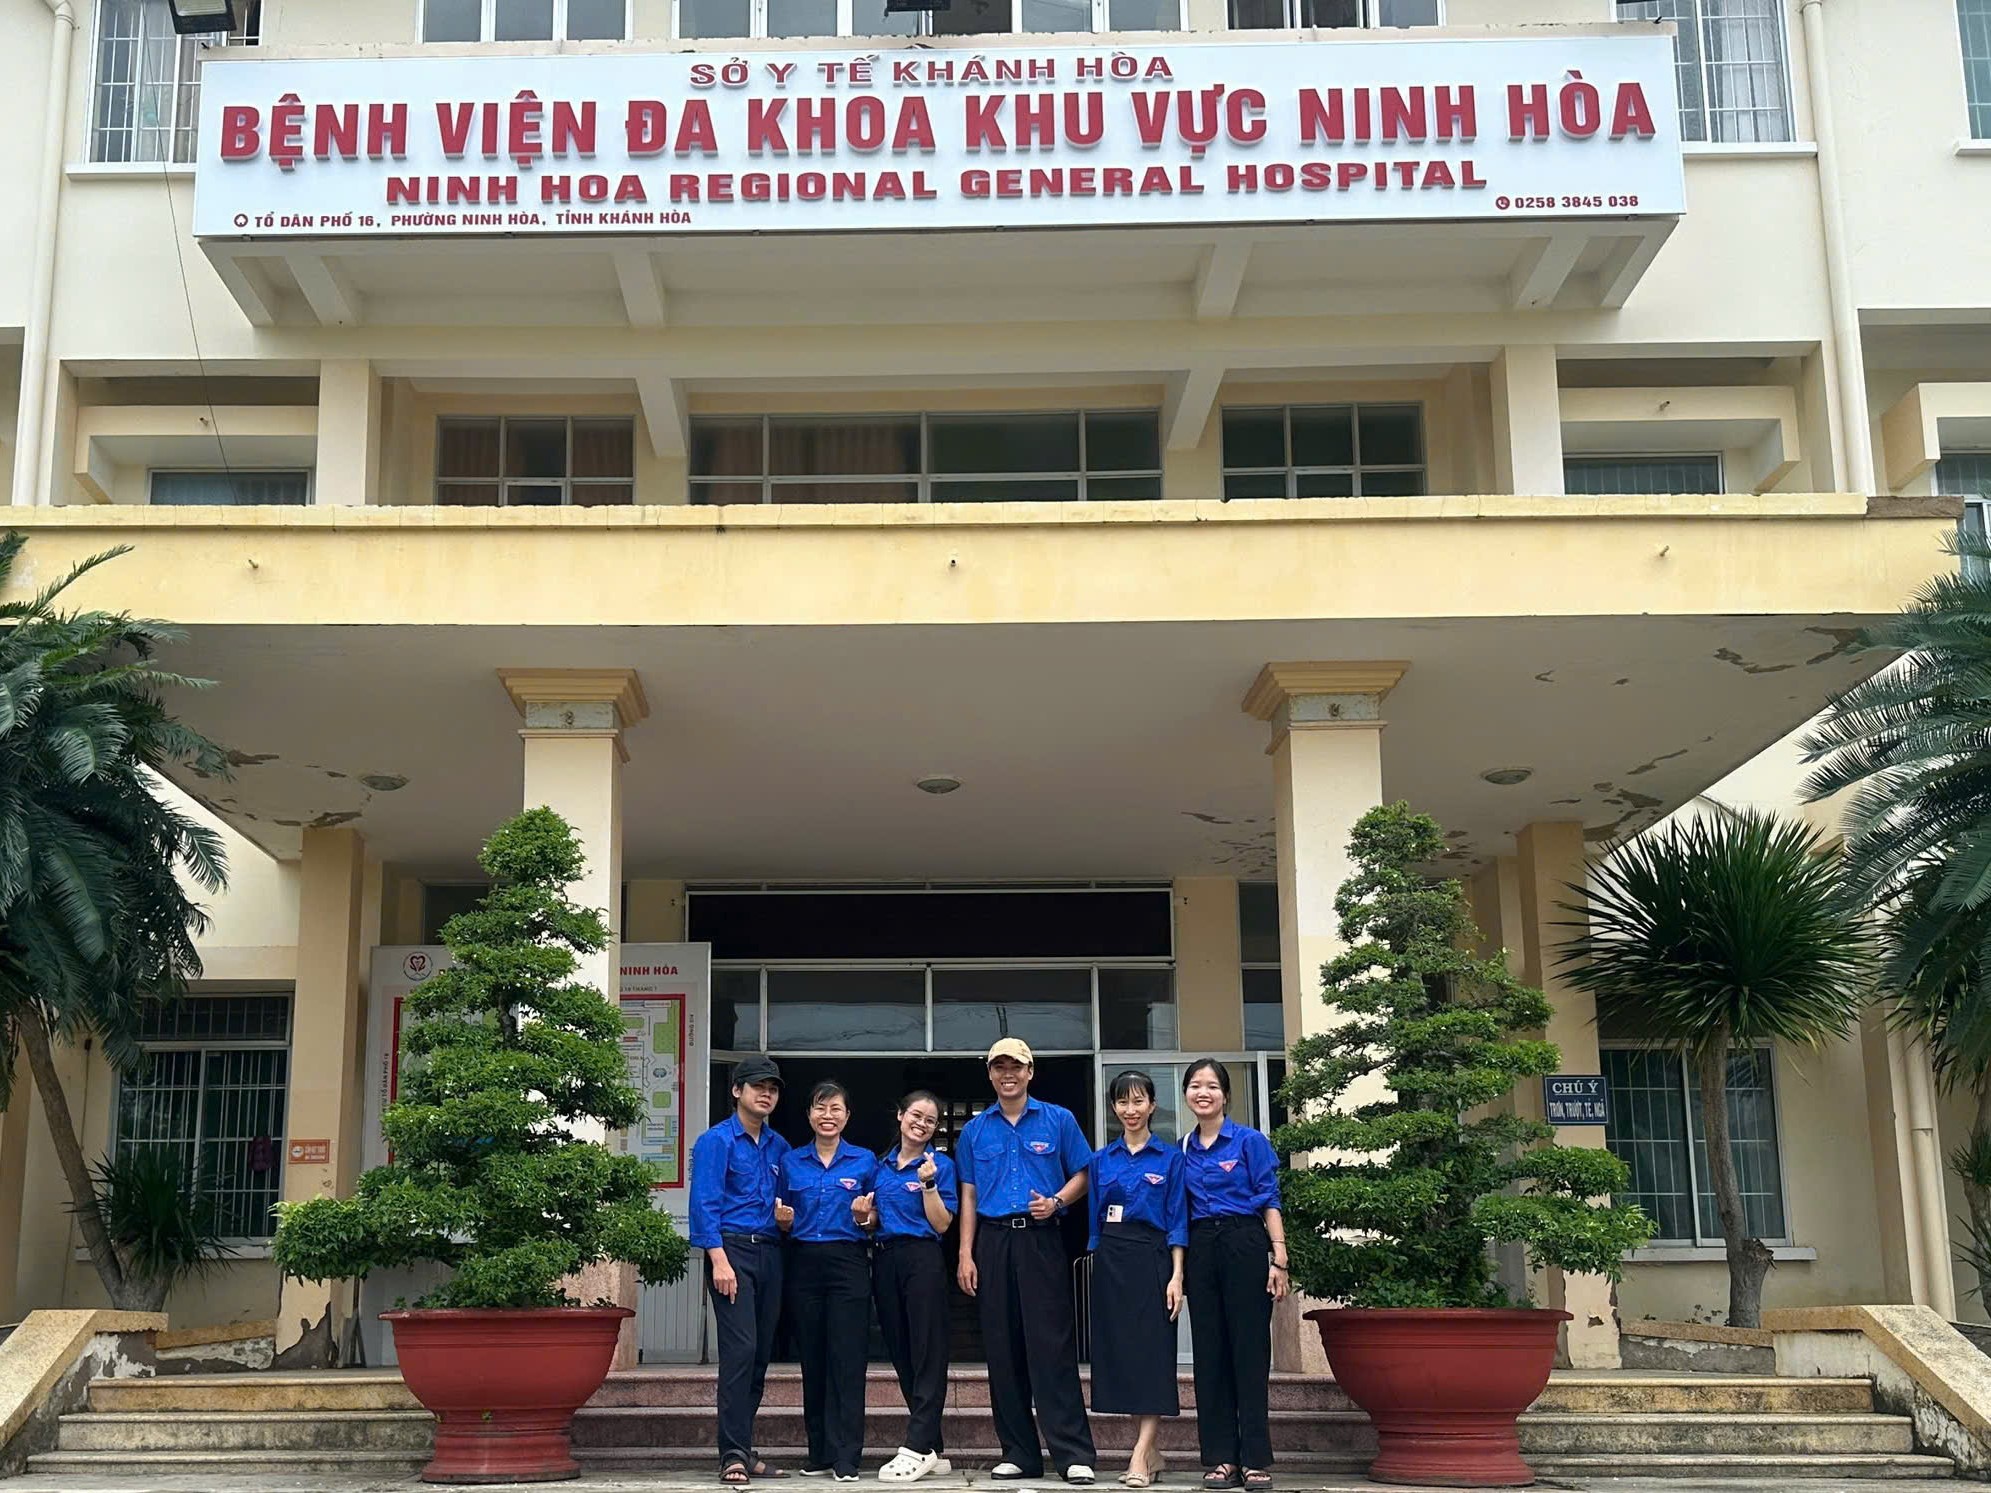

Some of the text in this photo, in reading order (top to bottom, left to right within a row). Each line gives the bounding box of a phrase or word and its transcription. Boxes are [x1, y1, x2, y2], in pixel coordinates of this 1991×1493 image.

[690, 52, 1173, 87] SỞ Y TẾ KHÁNH HÒA
[220, 70, 1656, 168] BỆNH VIỆN ĐA KHOA KHU VỰC NINH HÒA
[386, 160, 1486, 205] NINH HOA REGIONAL GENERAL HOSPITAL
[1514, 195, 1639, 209] 0258 3845 038
[255, 209, 692, 229] TỔ DÂN PHỐ 16, PHƯỜNG NINH HÒA, TỈNH KHÁNH HÒA
[619, 963, 678, 976] NINH HÒA
[1552, 1080, 1599, 1094] CHÚ Ý
